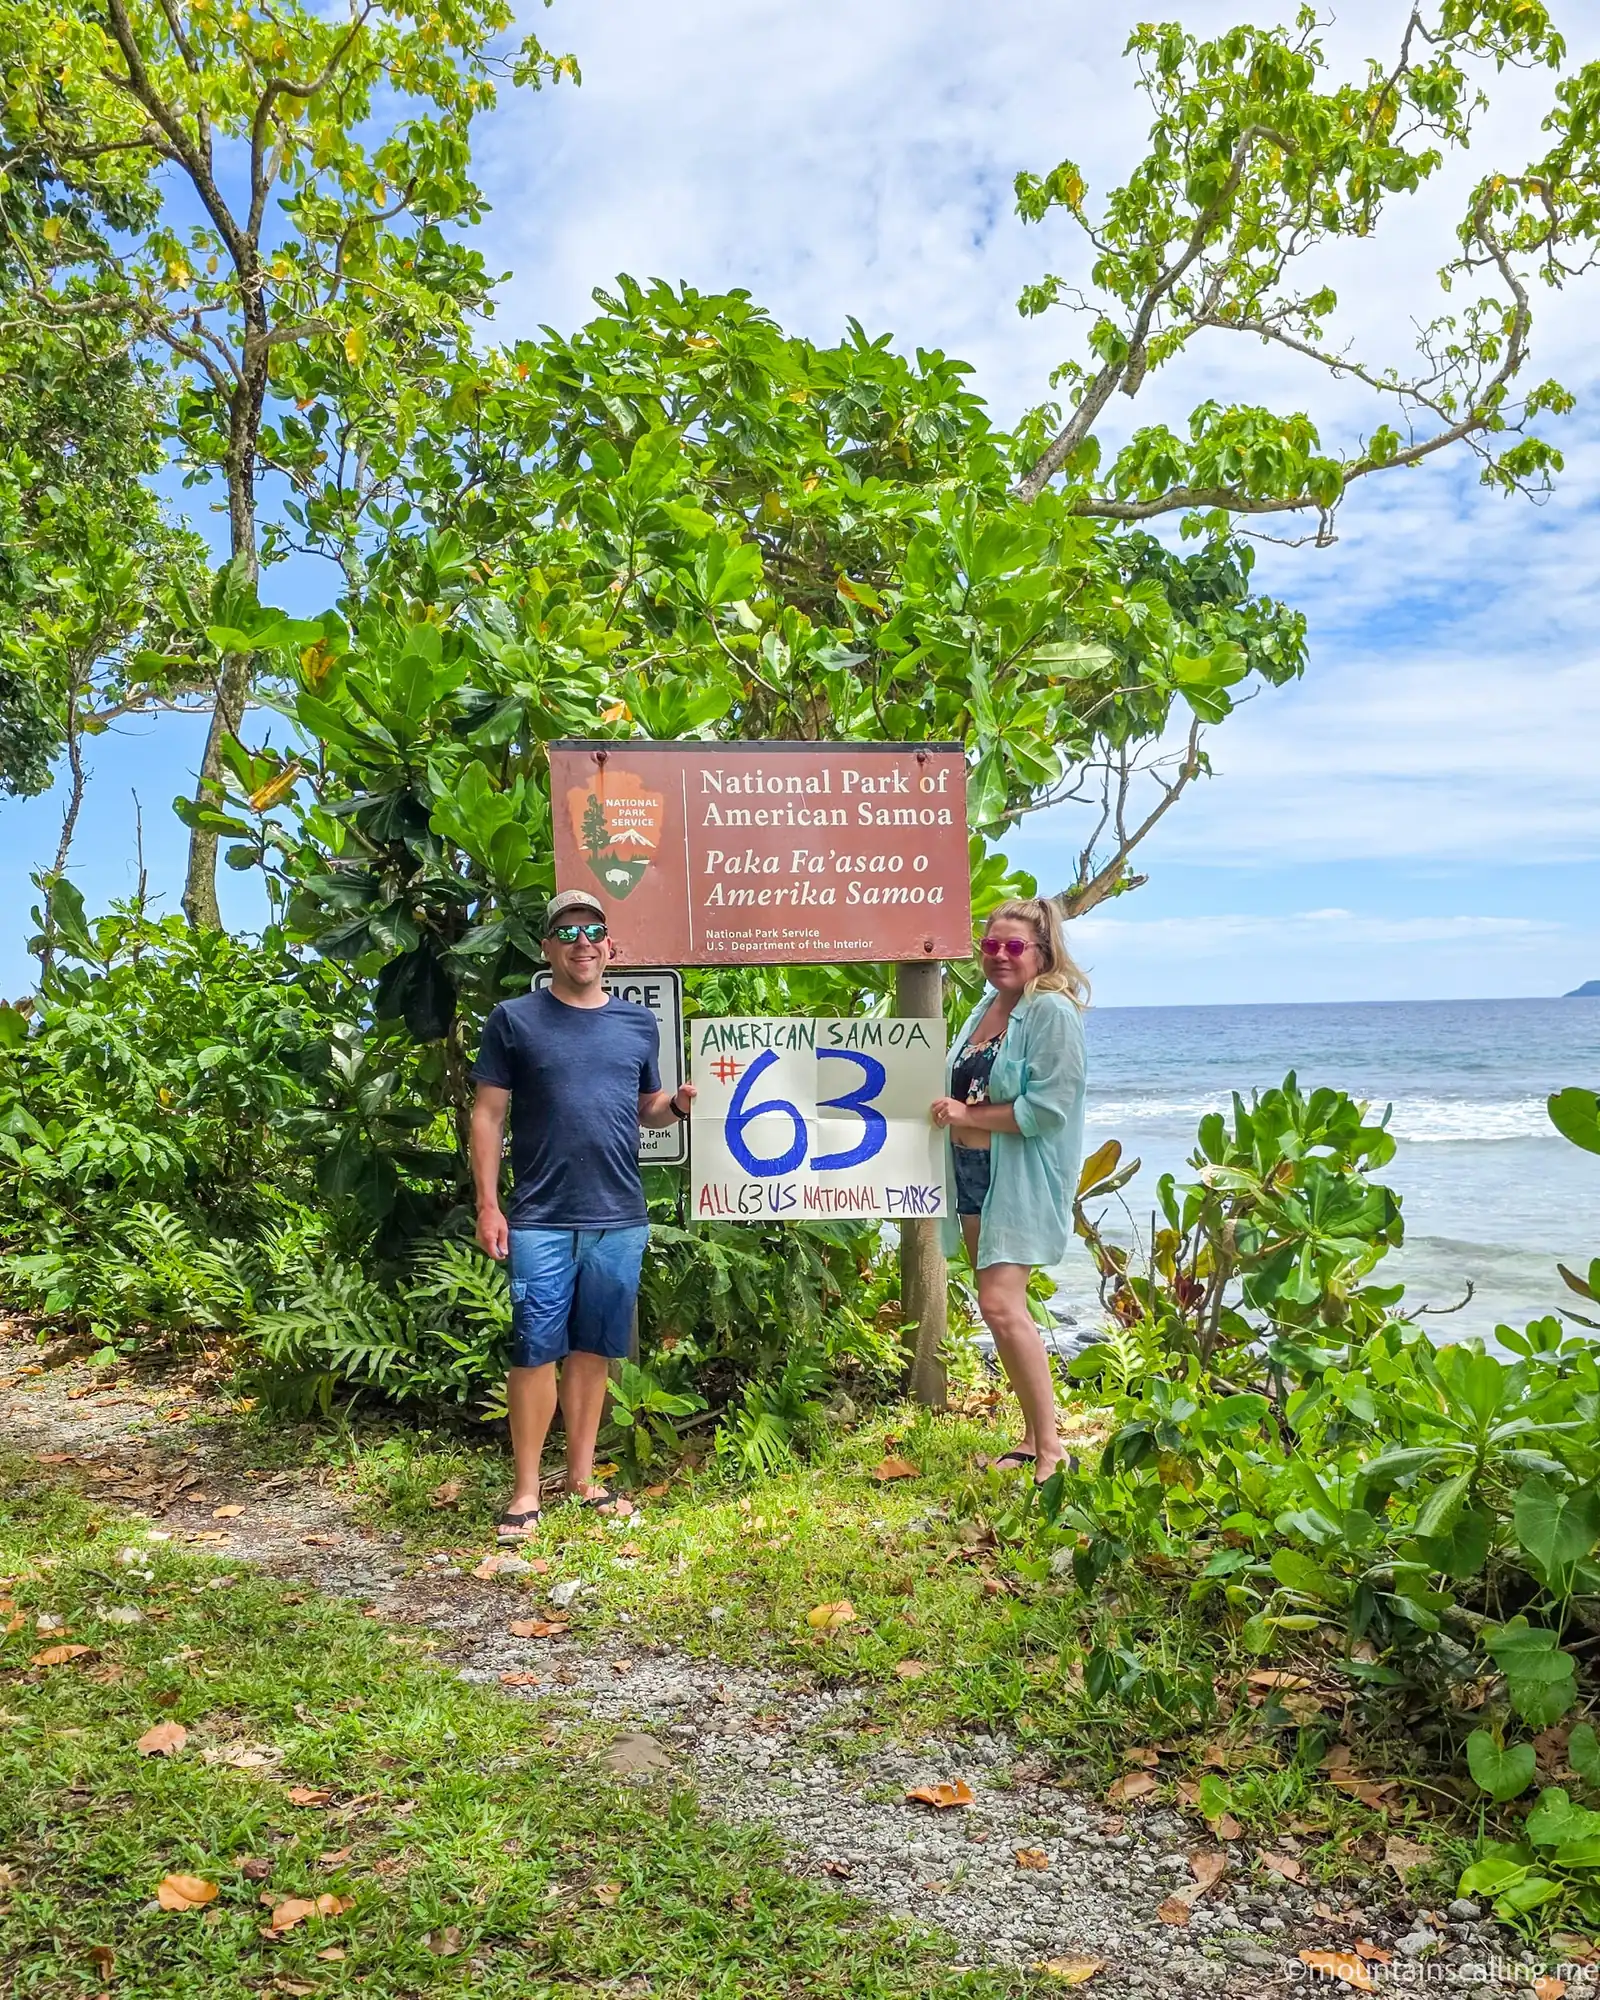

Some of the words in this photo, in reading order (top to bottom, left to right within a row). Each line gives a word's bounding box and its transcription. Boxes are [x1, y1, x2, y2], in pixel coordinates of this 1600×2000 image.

[700, 769, 831, 794] National
[841, 769, 910, 794] Park
[919, 769, 949, 793] of
[605, 799, 659, 807] NATIONAL
[618, 808, 646, 817] PARK
[611, 818, 654, 827] SERVICE
[702, 802, 849, 826] American
[857, 802, 953, 826] Samoa
[704, 849, 780, 874] Paka
[789, 849, 904, 874] Fa’asao
[912, 854, 929, 872] o
[704, 881, 837, 906] Amerika
[845, 881, 944, 905] Samoa
[706, 929, 752, 939] National
[755, 929, 779, 938] Park
[782, 928, 820, 938] Service
[706, 942, 728, 951] U.S.
[731, 940, 795, 953] Department
[798, 940, 810, 949] of
[813, 939, 831, 949] the
[833, 940, 873, 949] Interior
[700, 1018, 817, 1056] AMERICAN
[827, 1022, 931, 1049] SAMOA
[648, 1130, 671, 1139] Park
[699, 1183, 736, 1216] ALL
[737, 1184, 763, 1215] 63
[768, 1183, 797, 1214] US
[803, 1184, 881, 1212] NATIONAL
[885, 1185, 943, 1214] PARKS
